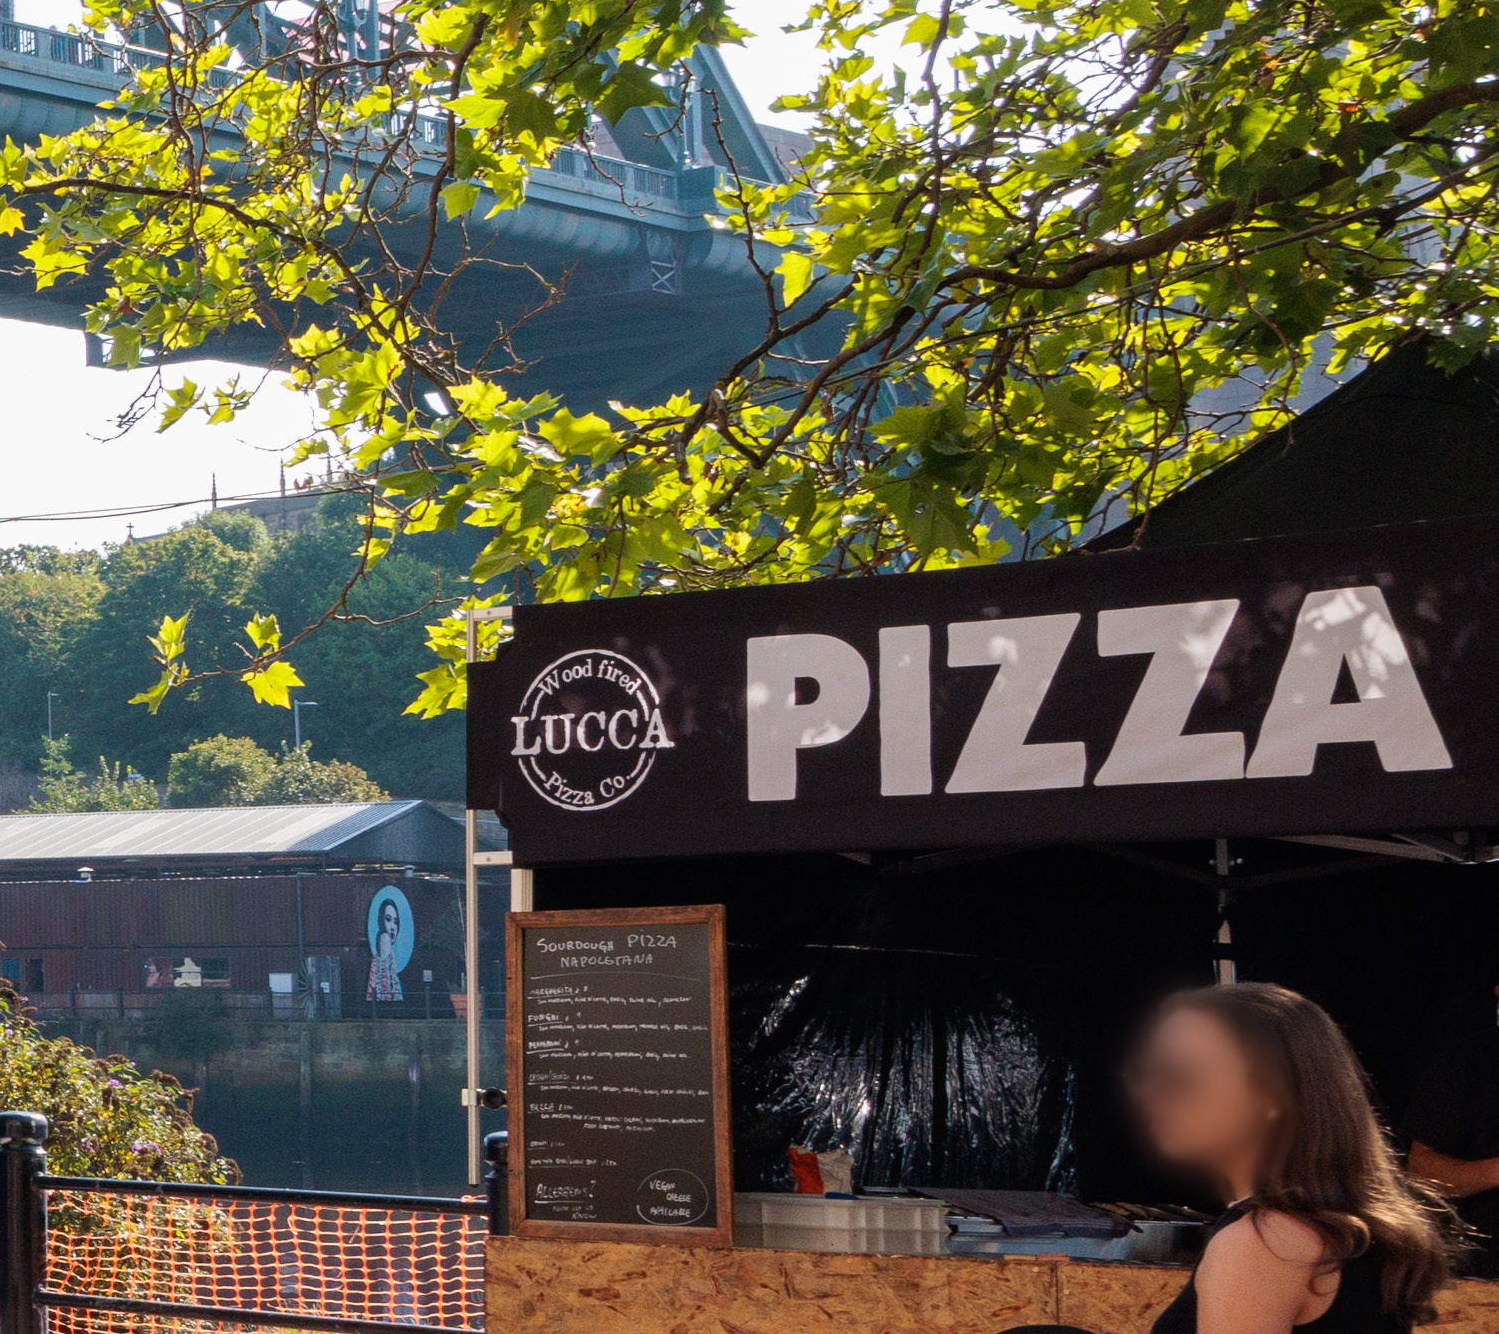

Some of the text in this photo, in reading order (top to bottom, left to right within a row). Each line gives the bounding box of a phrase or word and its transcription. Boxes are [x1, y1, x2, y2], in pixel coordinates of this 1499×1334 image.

[538, 659, 642, 695] Wood fired
[746, 585, 1453, 802] PIZZA
[510, 707, 675, 756] LUCCA
[543, 771, 631, 805] Pizza Co.
[536, 930, 677, 953] SOURDOUGH PIZZA
[649, 1179, 675, 1191] VEGAN
